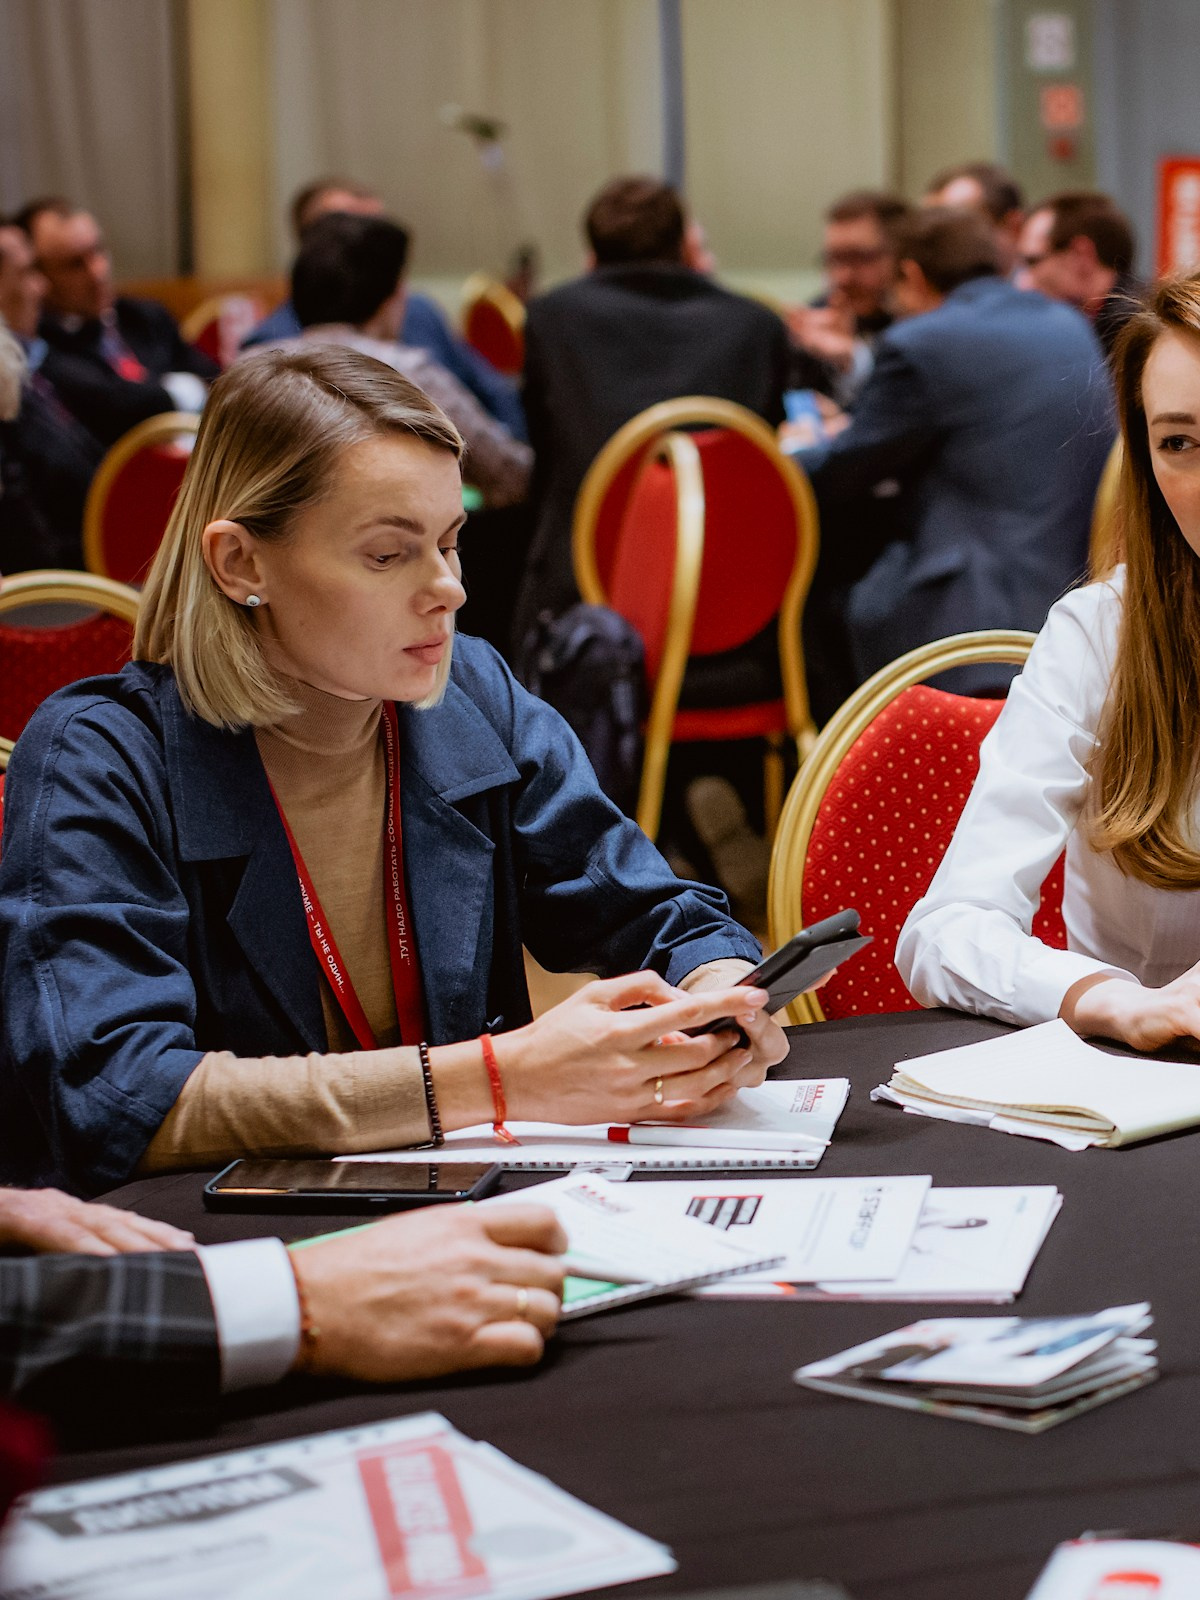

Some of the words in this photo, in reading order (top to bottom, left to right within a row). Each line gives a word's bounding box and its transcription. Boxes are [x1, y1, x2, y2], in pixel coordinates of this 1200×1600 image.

[380, 705, 396, 788] ПОДЕЛИВШИС
[390, 844, 401, 901] РАБОТАТЬ
[395, 902, 407, 936] НАДО
